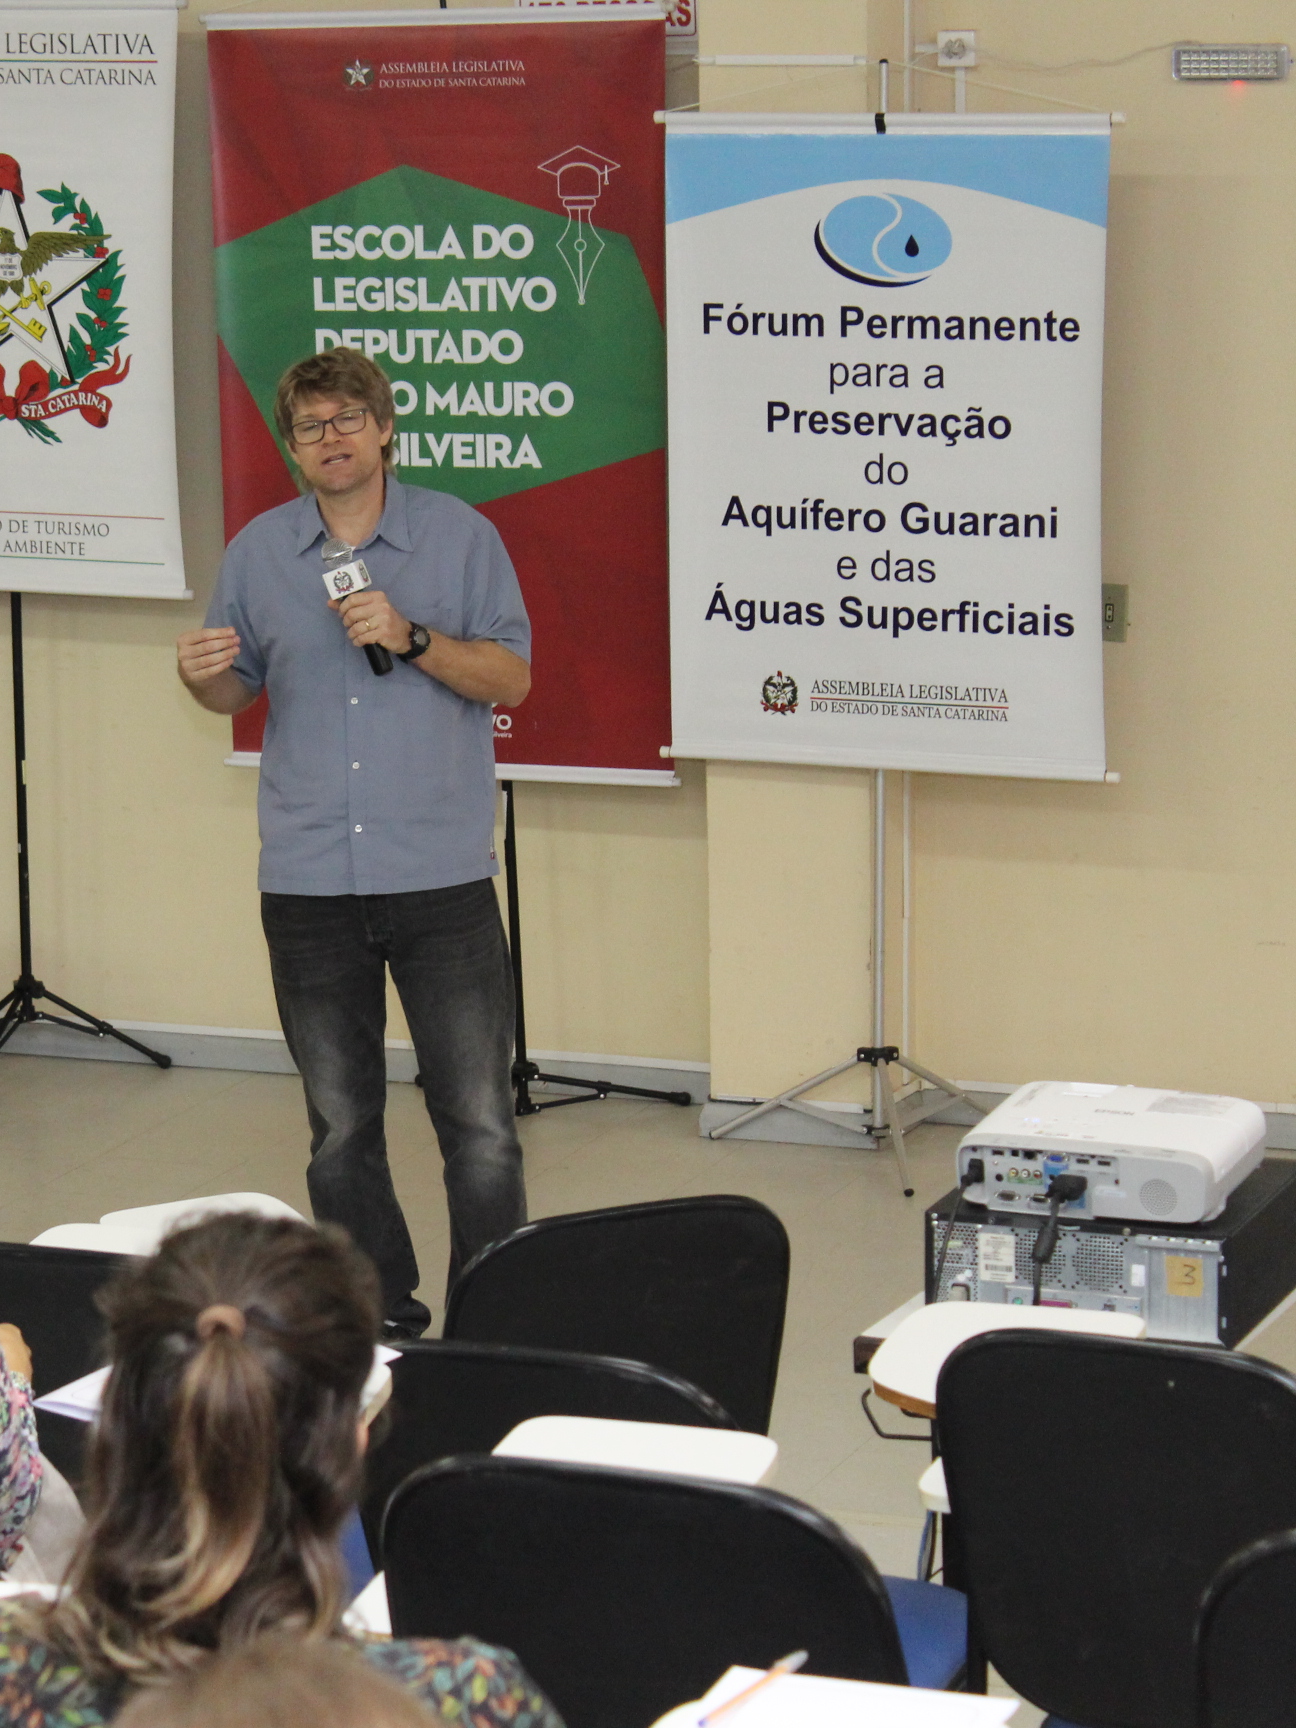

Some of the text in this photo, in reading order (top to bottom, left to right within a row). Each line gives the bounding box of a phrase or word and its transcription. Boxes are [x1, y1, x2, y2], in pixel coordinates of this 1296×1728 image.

[5, 32, 155, 56] LEGISLATIVA
[59, 67, 157, 87] CATARINA
[379, 59, 525, 74] ASSEMBLEIA LEGISLATIVA
[379, 77, 526, 89] DO ESTADO DE SANTA CATARINA
[311, 224, 534, 260] ESCOLA DO
[312, 276, 557, 313] LEGISLATIVO
[702, 303, 1081, 342] Fórum Permanente
[830, 361, 945, 395] para a
[48, 391, 108, 414] CATARINA
[425, 381, 574, 417] MAURO
[766, 401, 1012, 447] Preservação
[864, 453, 909, 486] do
[8, 519, 29, 533] DE
[34, 520, 110, 537] TURISMO
[722, 495, 1059, 539] Aquífero Guarani
[3, 540, 86, 556] AMBIENTE
[836, 550, 936, 584] e das
[705, 582, 1075, 638] Águas Superficiais
[811, 679, 1008, 703] ASSEMBLEIA LEGISLATIVA
[810, 700, 1008, 722] DO ESTADO DE SANTA CATARINA
